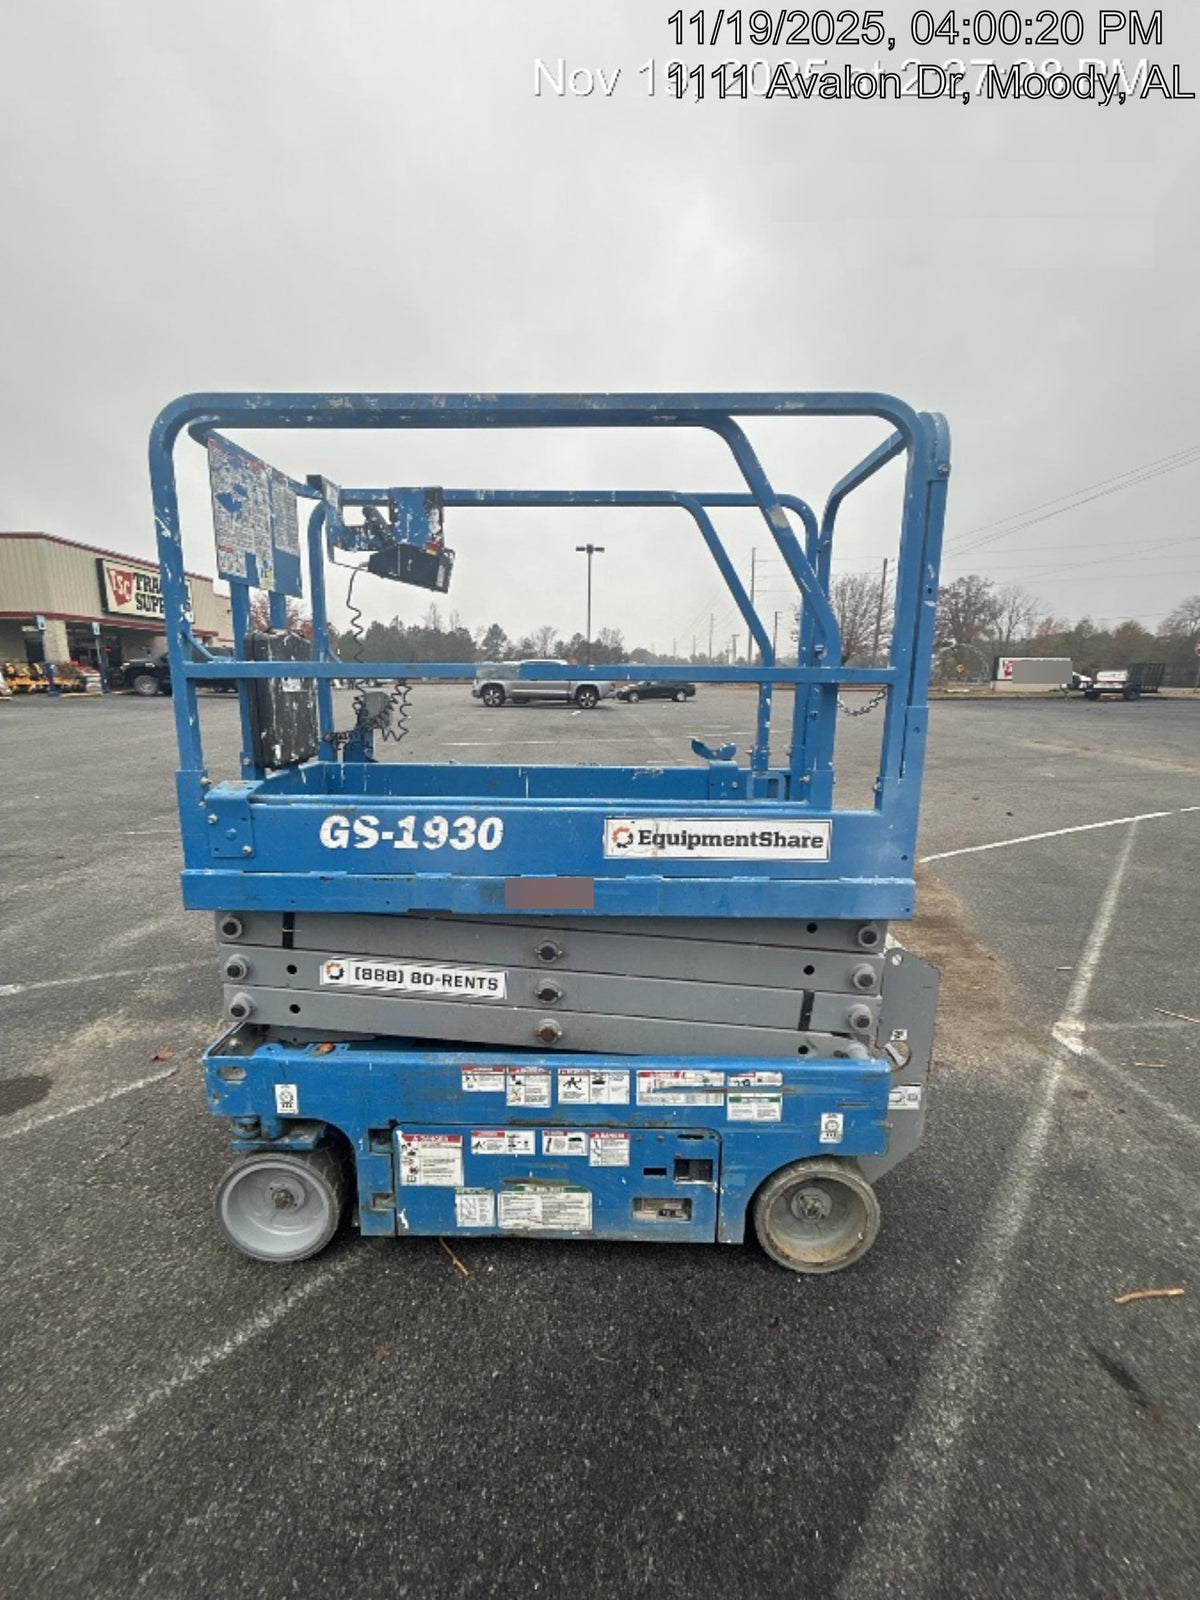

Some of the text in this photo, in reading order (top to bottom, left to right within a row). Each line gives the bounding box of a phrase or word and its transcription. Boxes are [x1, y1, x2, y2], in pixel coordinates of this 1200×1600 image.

[109, 569, 131, 601] TSC
[319, 814, 505, 850] GS-1930
[637, 829, 824, 850] EquipmentShare
[410, 971, 499, 991] 80-RENTS
